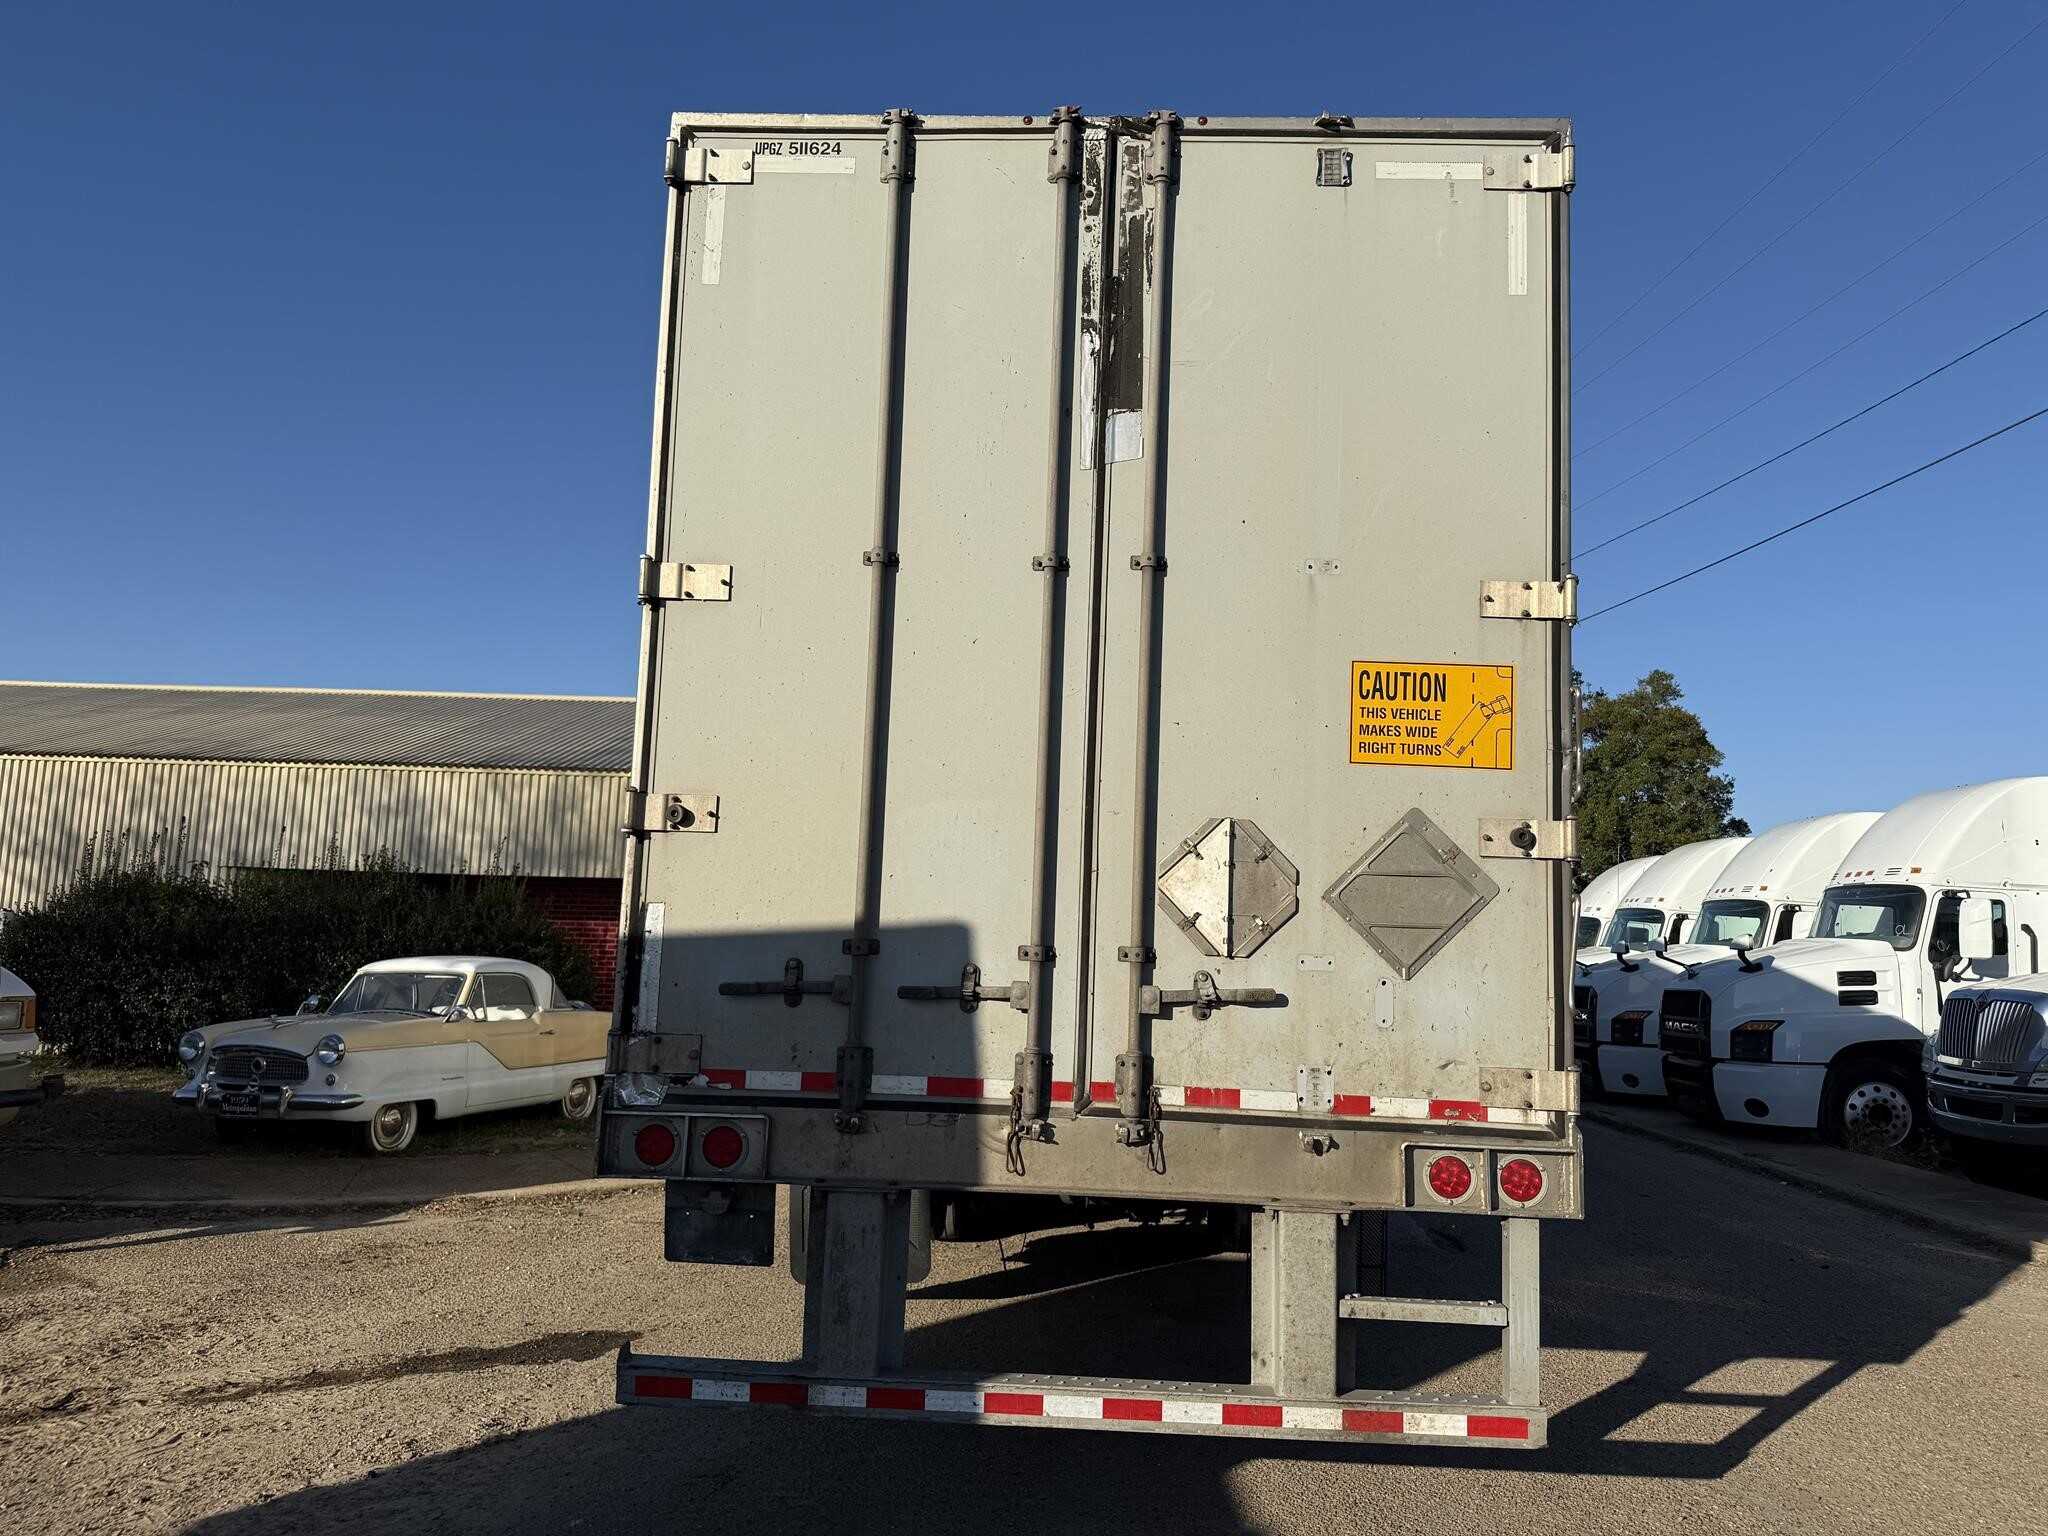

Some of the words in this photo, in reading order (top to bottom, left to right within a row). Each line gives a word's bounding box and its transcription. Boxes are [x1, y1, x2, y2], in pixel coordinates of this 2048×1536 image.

[755, 142, 783, 155] UPGZ
[788, 141, 842, 155] 511624
[1358, 669, 1447, 702] CAUTION
[1359, 706, 1387, 720] THIS
[1391, 707, 1442, 721] VEHICLE
[1359, 724, 1401, 738] MAKES
[1405, 726, 1438, 739] WIDE
[1358, 741, 1396, 755] RIGHT
[1399, 743, 1442, 756] TURNS
[1664, 1020, 1699, 1031] MACK
